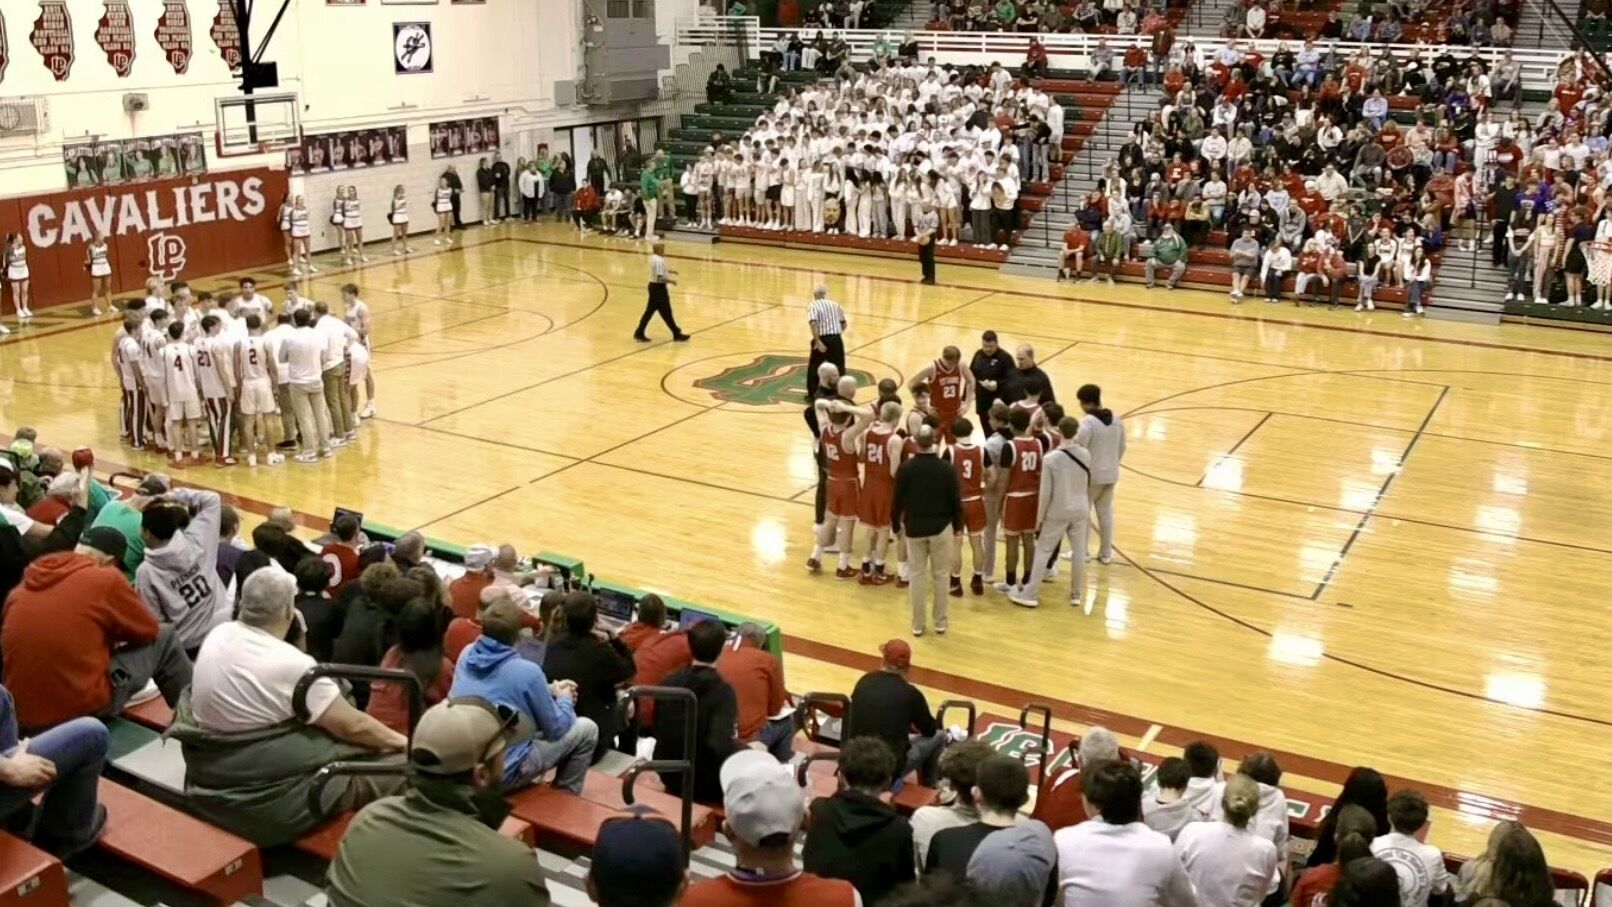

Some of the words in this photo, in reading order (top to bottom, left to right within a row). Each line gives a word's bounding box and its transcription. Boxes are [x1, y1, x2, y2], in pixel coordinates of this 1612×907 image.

[28, 176, 266, 248] CAVALIERS
[148, 232, 186, 280] LP
[174, 354, 183, 371] 4
[249, 348, 258, 365] 2
[867, 443, 883, 464] 24
[1021, 451, 1037, 472] 20
[962, 459, 973, 479] 3
[179, 575, 212, 608] 20
